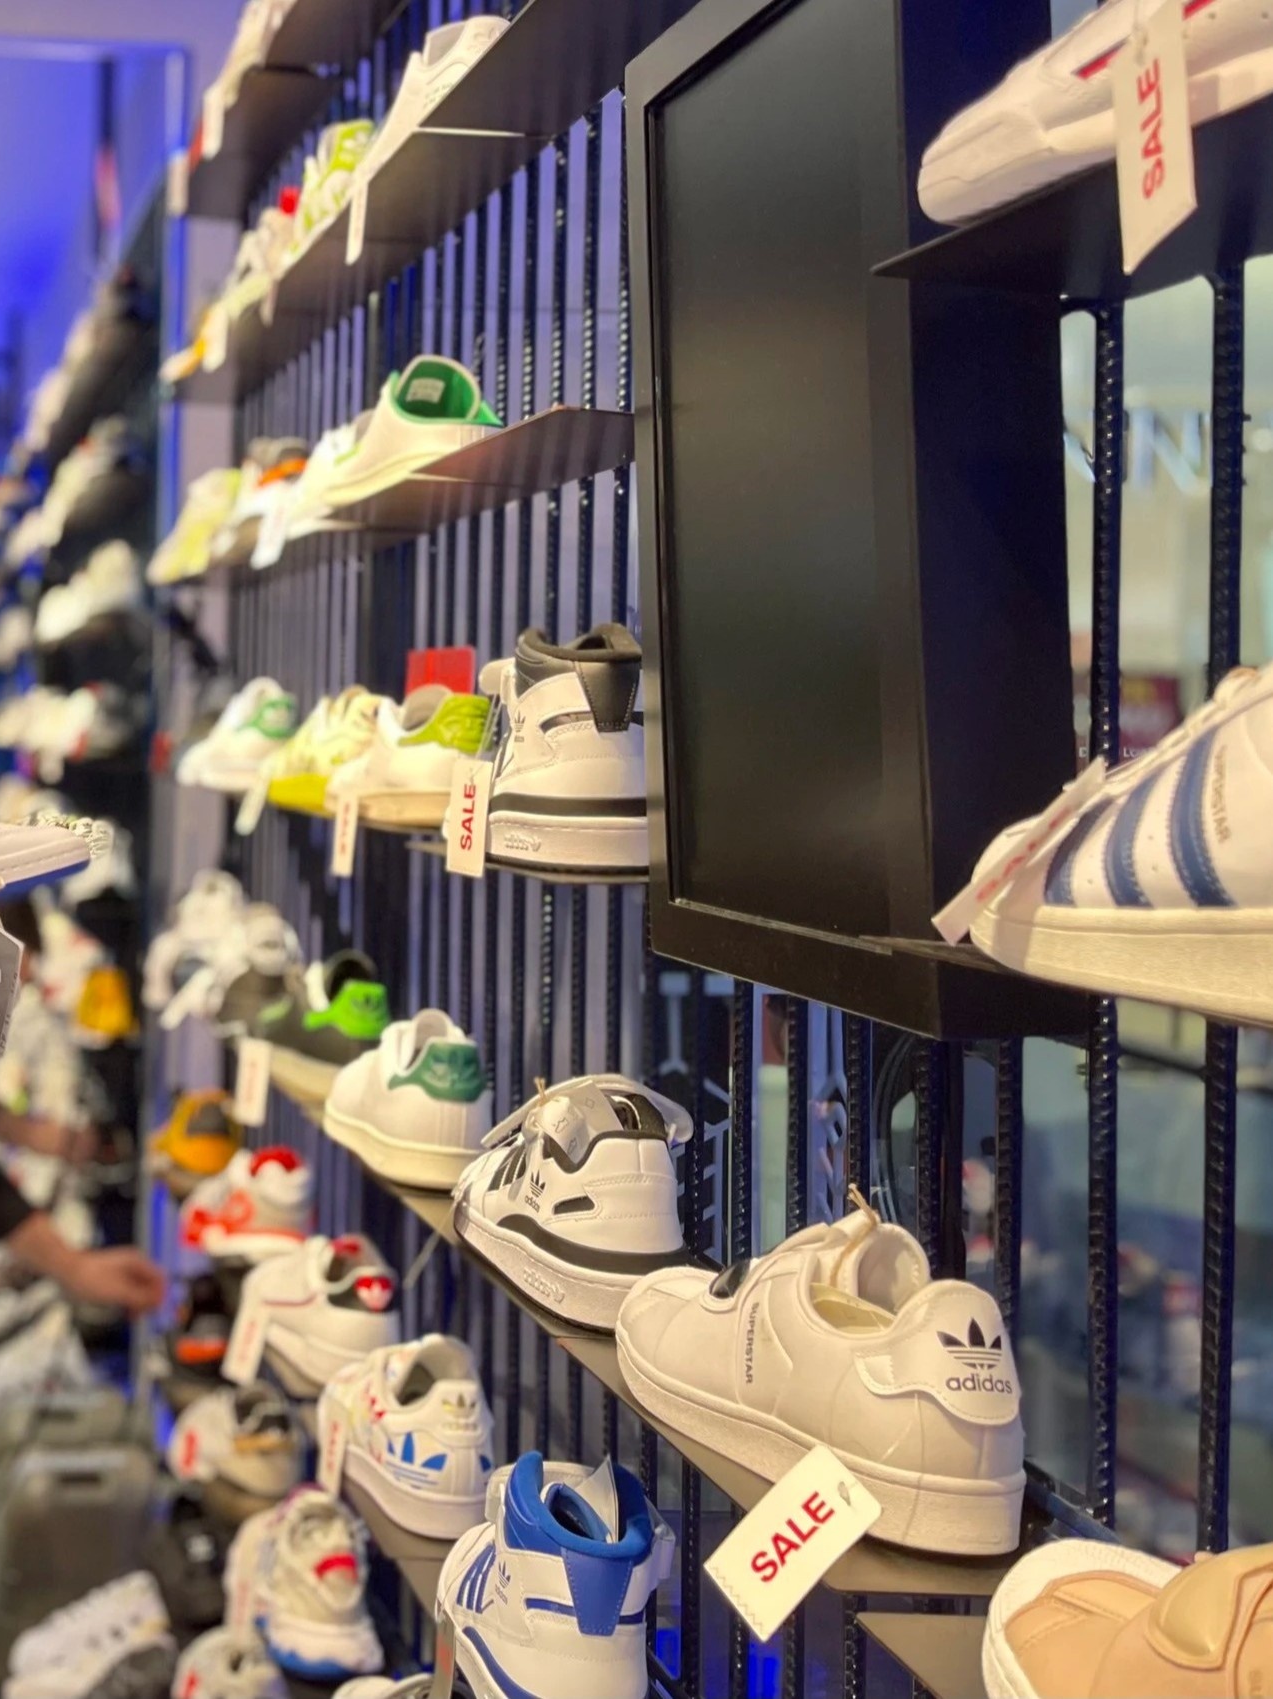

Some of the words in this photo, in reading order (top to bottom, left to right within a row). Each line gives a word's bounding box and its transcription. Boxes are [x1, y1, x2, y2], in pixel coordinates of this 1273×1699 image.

[1136, 58, 1166, 200] SALE
[460, 784, 477, 851] SALE
[744, 1301, 760, 1385] SUPERSTAR
[945, 1371, 1013, 1394] adidas
[750, 1491, 836, 1583] SALE
